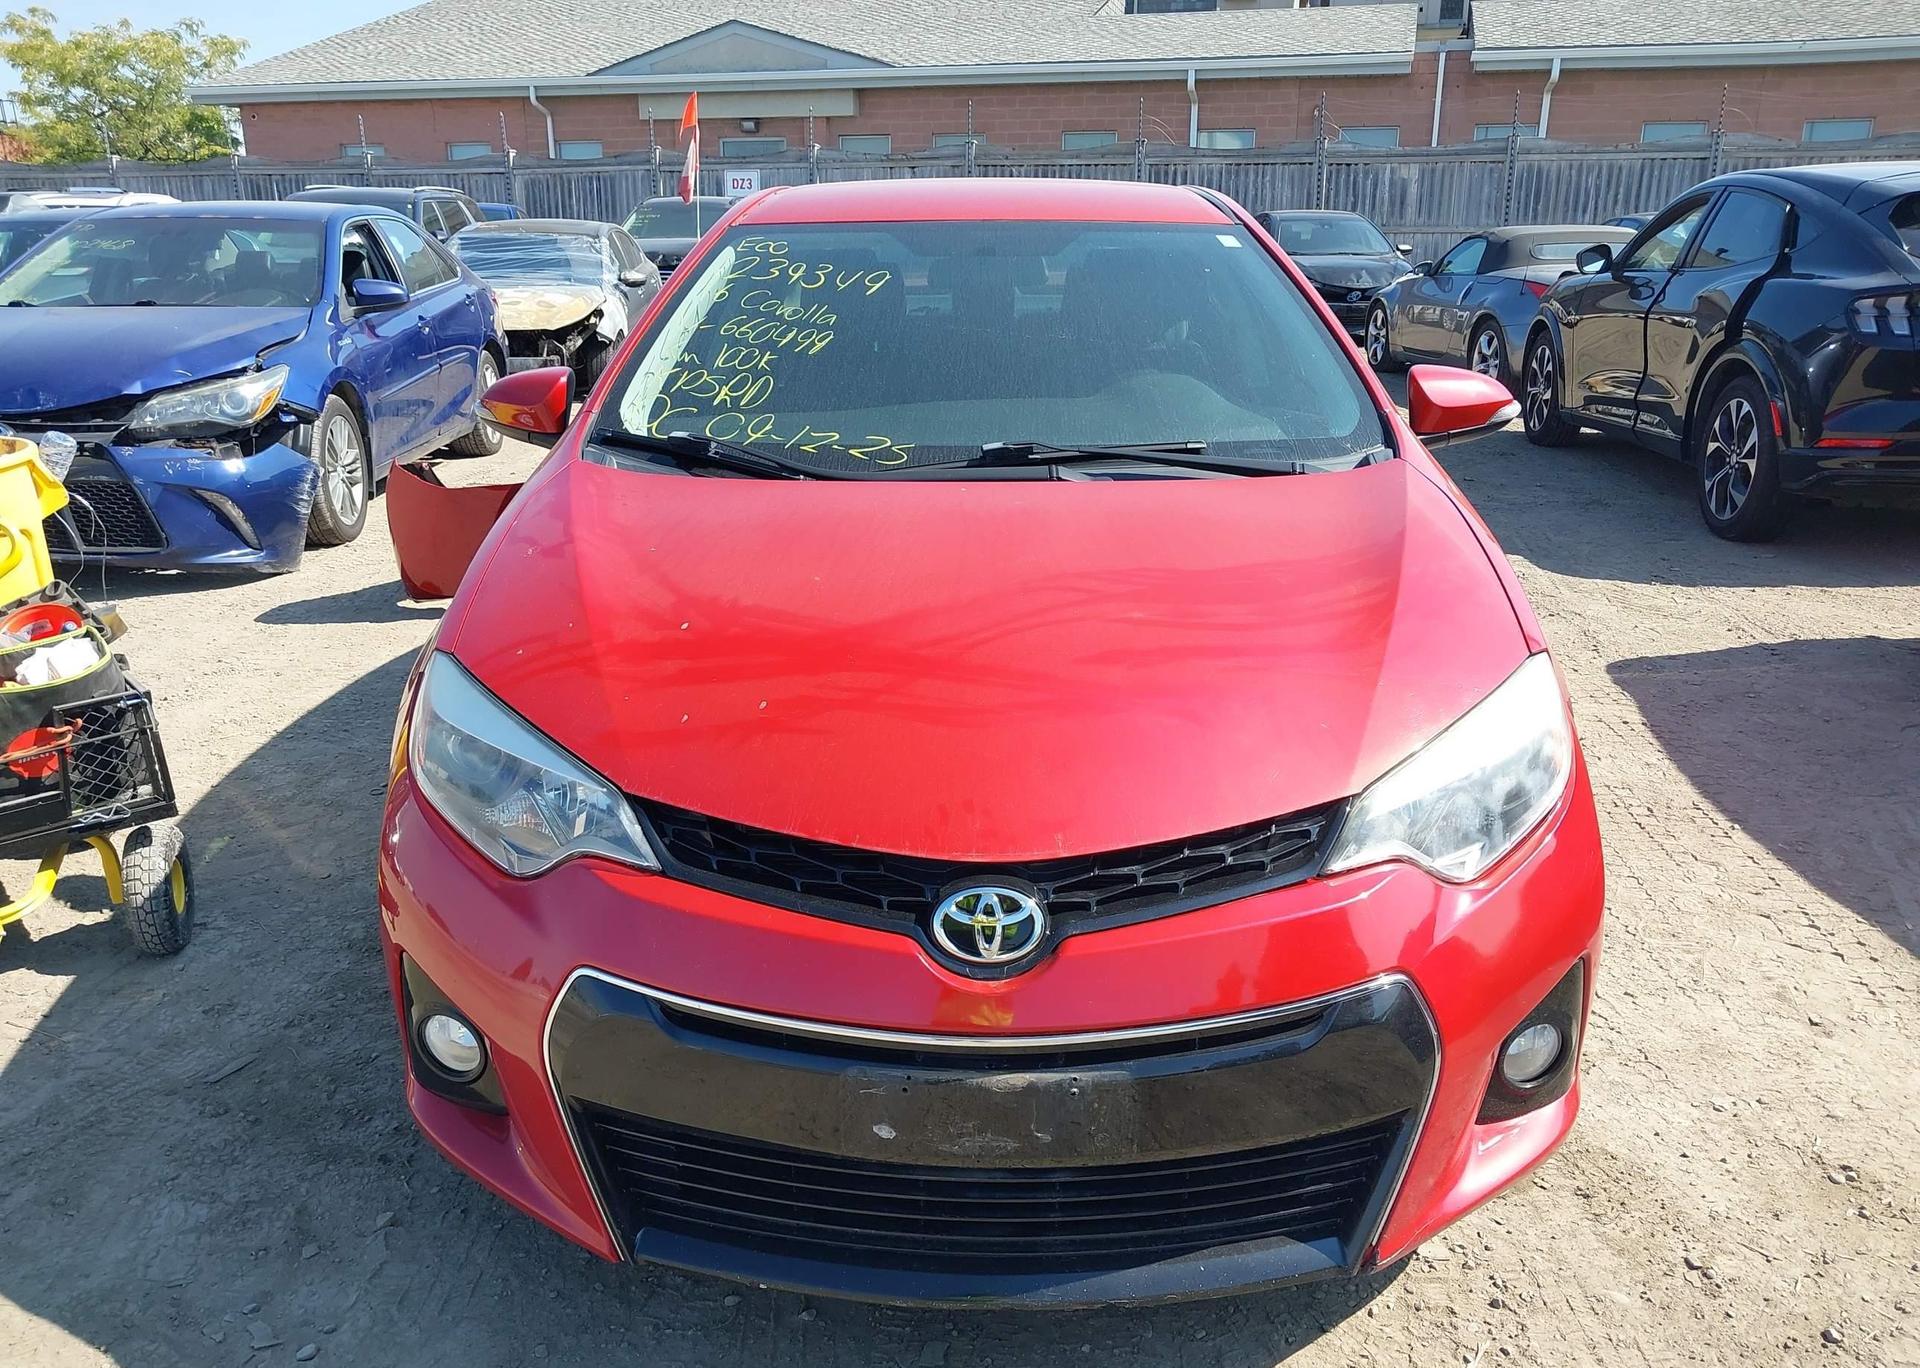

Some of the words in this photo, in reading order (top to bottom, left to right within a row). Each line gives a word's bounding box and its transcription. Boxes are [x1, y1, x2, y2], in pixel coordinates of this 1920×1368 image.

[732, 178, 752, 190] DZ3
[724, 256, 892, 296] 239349
[740, 290, 837, 326] Corolla
